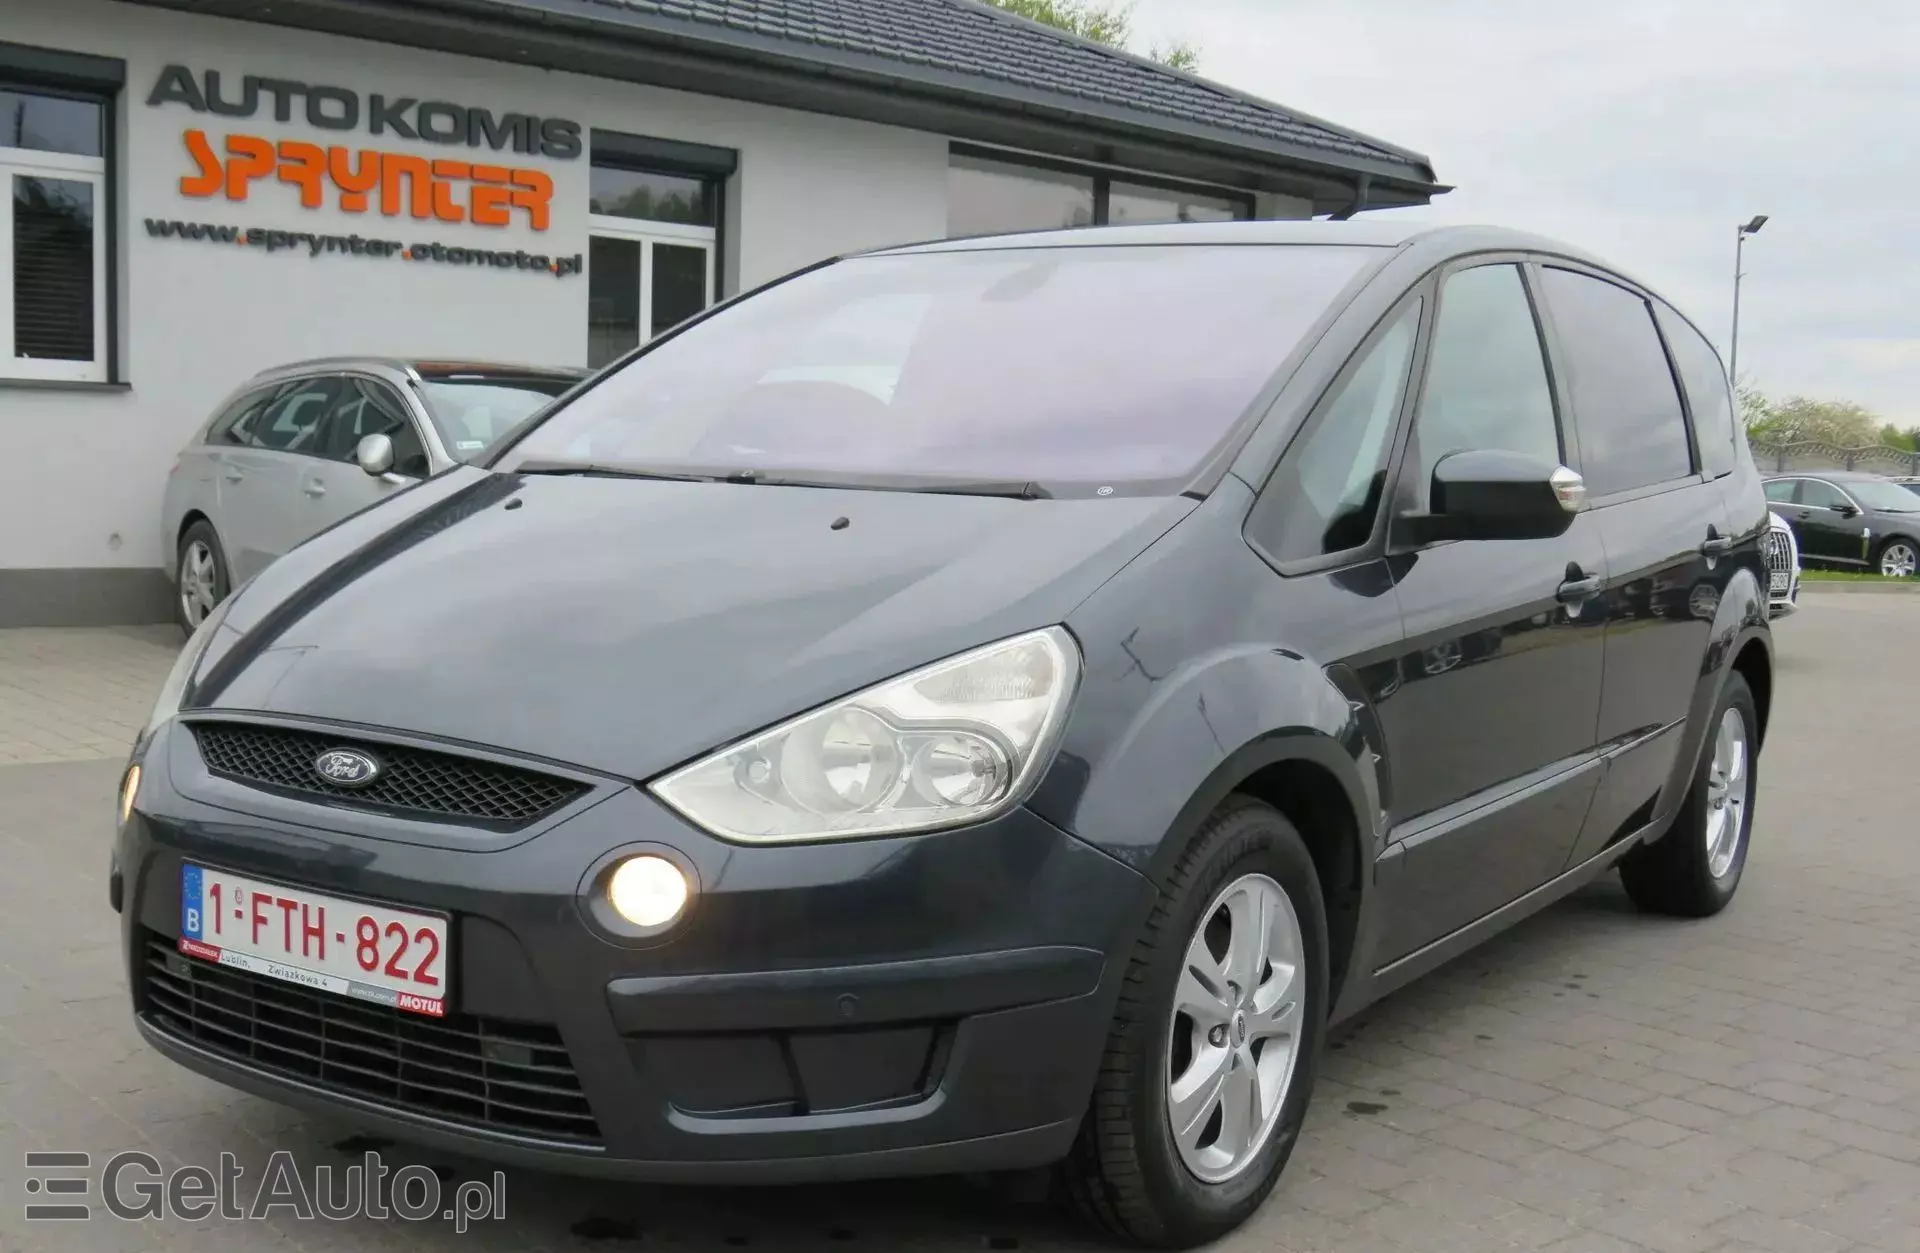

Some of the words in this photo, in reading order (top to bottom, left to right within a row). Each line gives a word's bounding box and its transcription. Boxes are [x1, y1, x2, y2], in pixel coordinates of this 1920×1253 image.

[145, 64, 359, 131] AUTO
[368, 93, 583, 159] KOMIS
[180, 129, 554, 231] SPRYNTER
[144, 218, 583, 278] www.sprynter.otomoto.pl
[325, 755, 361, 778] Ford
[186, 908, 200, 932] B
[209, 882, 439, 986] 1-FTH-822
[400, 994, 443, 1014] MOTUL
